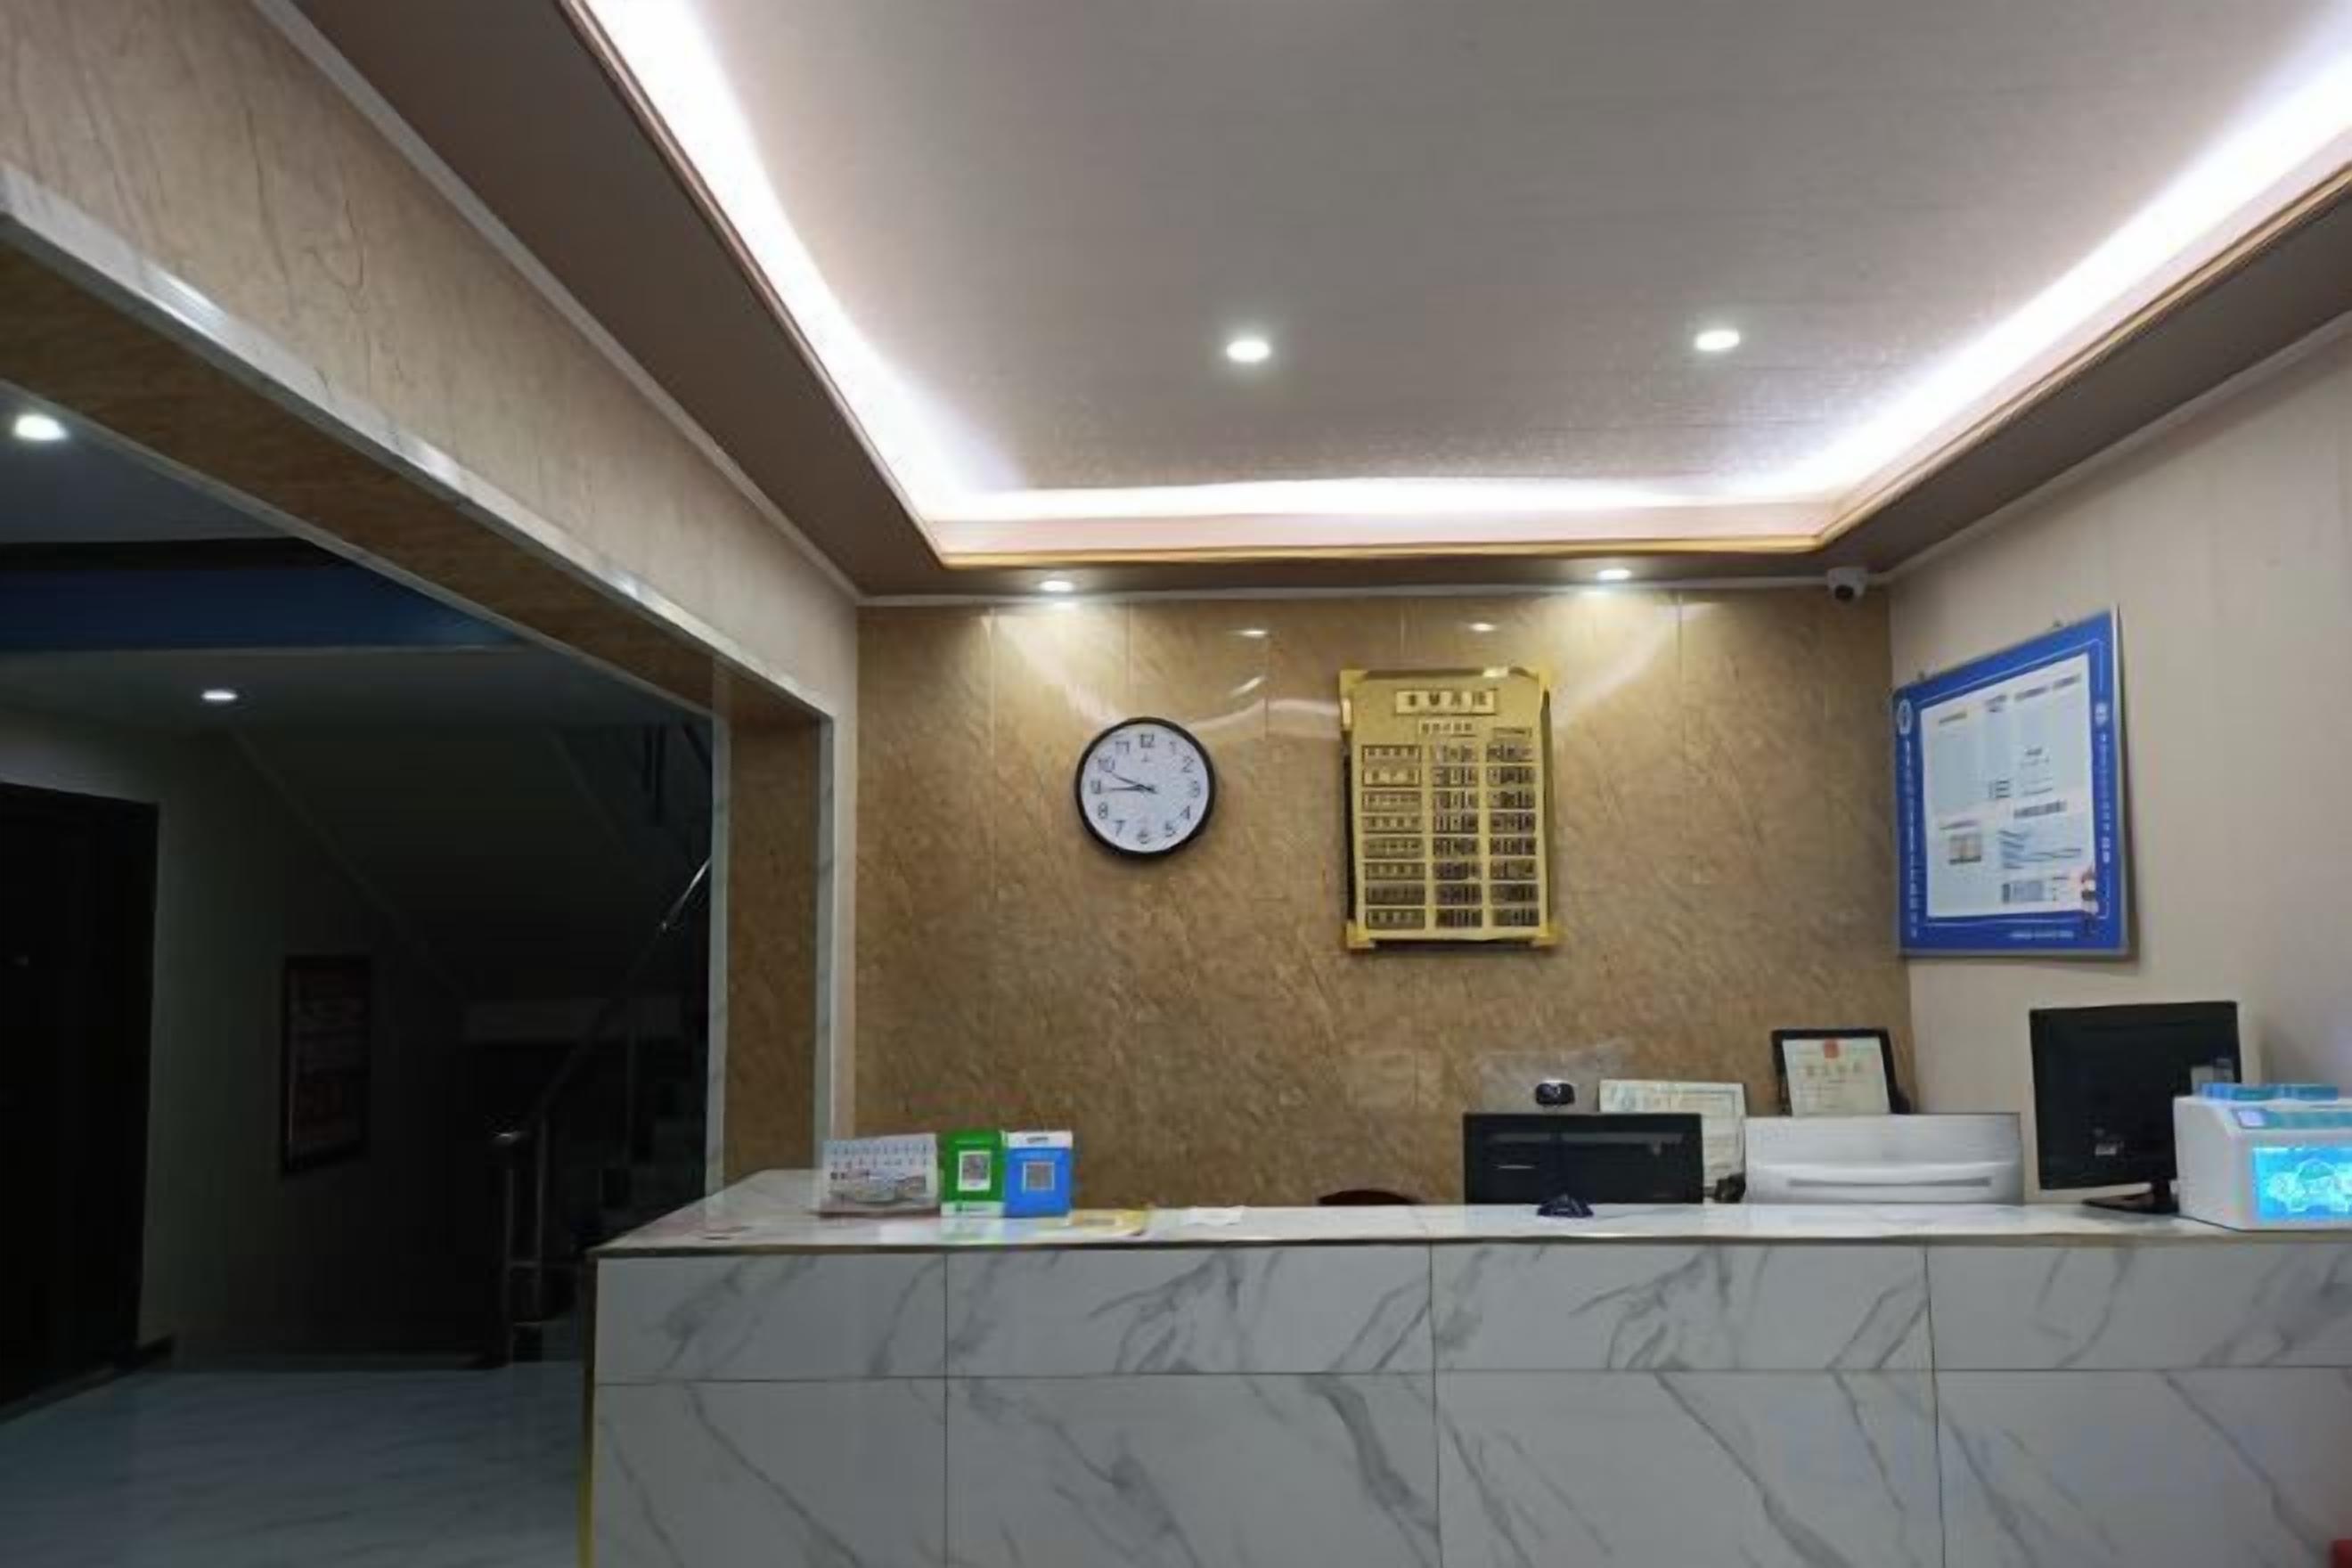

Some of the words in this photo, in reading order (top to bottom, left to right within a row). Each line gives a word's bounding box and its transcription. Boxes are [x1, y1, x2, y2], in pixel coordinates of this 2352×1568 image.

[1115, 740, 1130, 755] 11
[1140, 733, 1155, 748] 12
[1169, 740, 1177, 755] 1
[1098, 755, 1115, 773] 10
[1181, 755, 1195, 773] 2
[1090, 780, 1101, 795] 9
[1189, 780, 1201, 798] 3
[1098, 802, 1108, 820] 8
[1179, 804, 1190, 821] 4
[1115, 819, 1126, 837] 7
[1137, 828, 1149, 845] 6
[1164, 820, 1177, 838] 5
